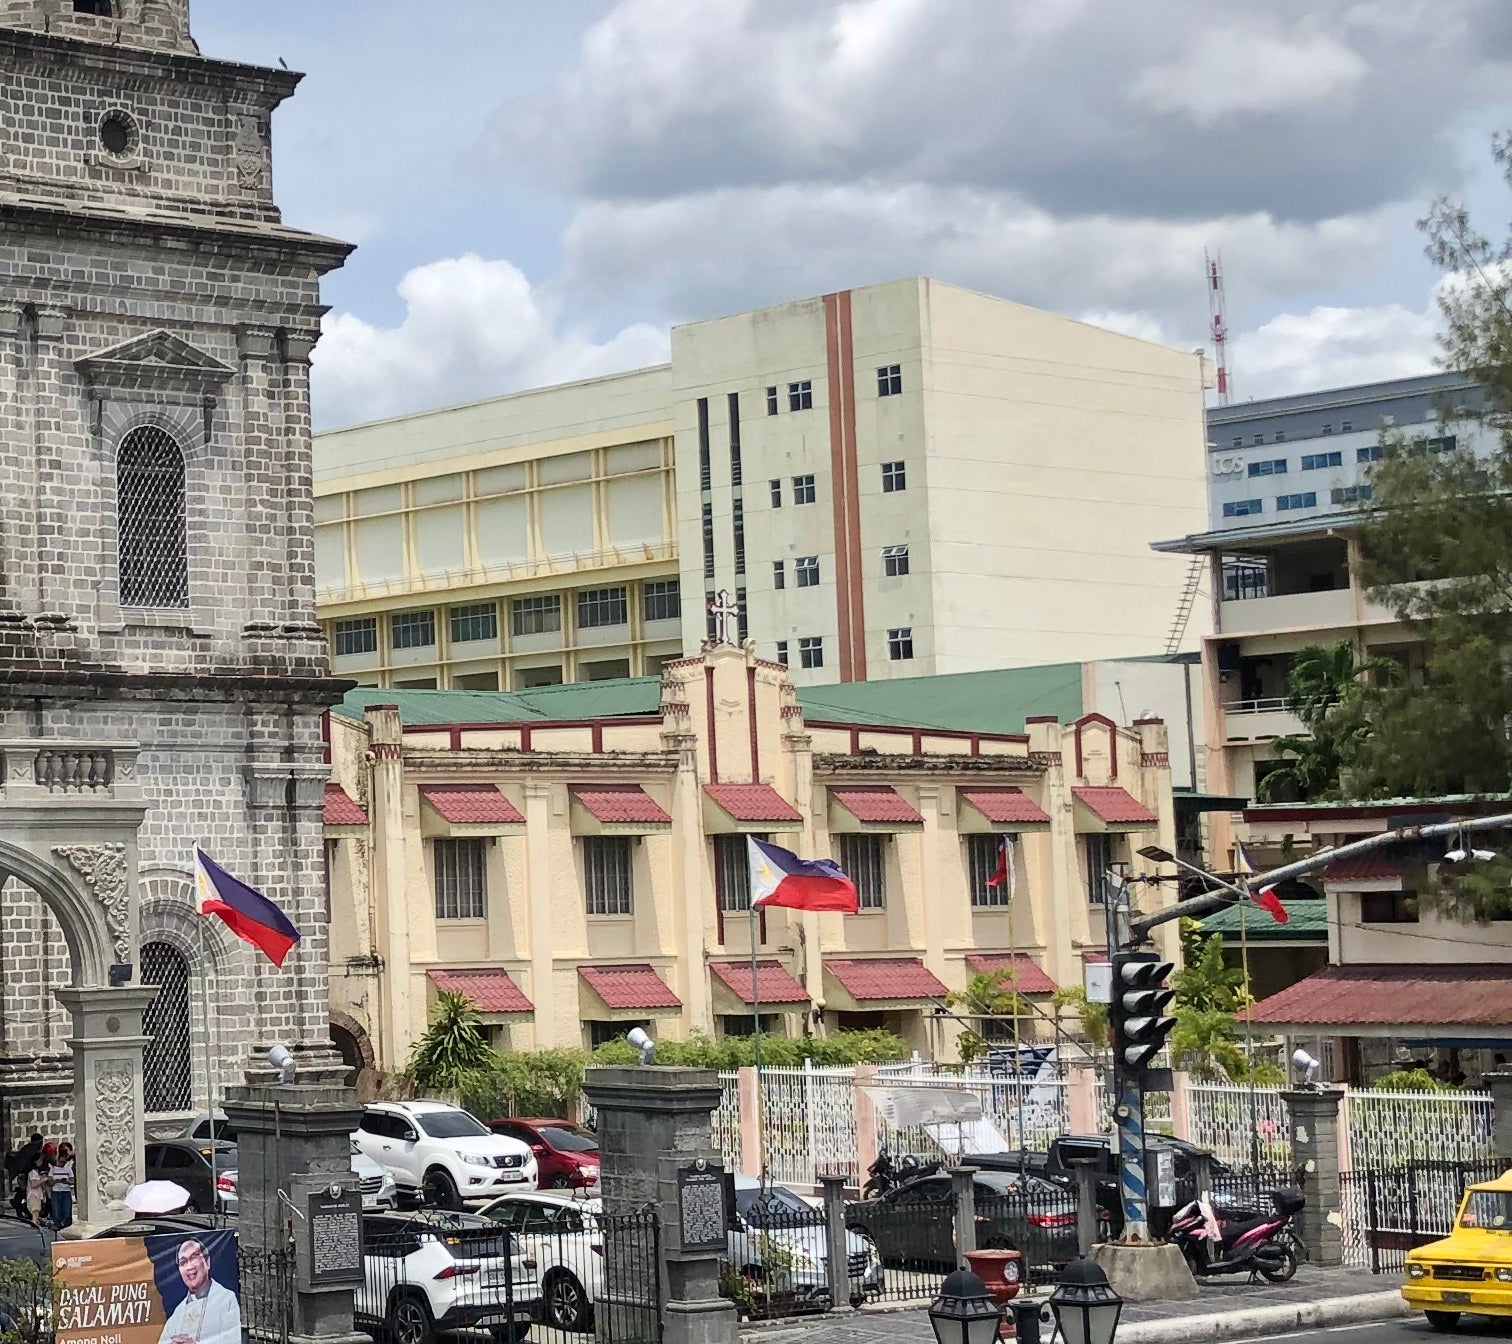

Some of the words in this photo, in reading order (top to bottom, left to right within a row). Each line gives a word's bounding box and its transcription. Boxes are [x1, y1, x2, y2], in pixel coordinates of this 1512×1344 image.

[59, 1286, 106, 1306] DACAL
[110, 1283, 148, 1303] PUNG
[57, 1300, 151, 1330] SALAMAT!
